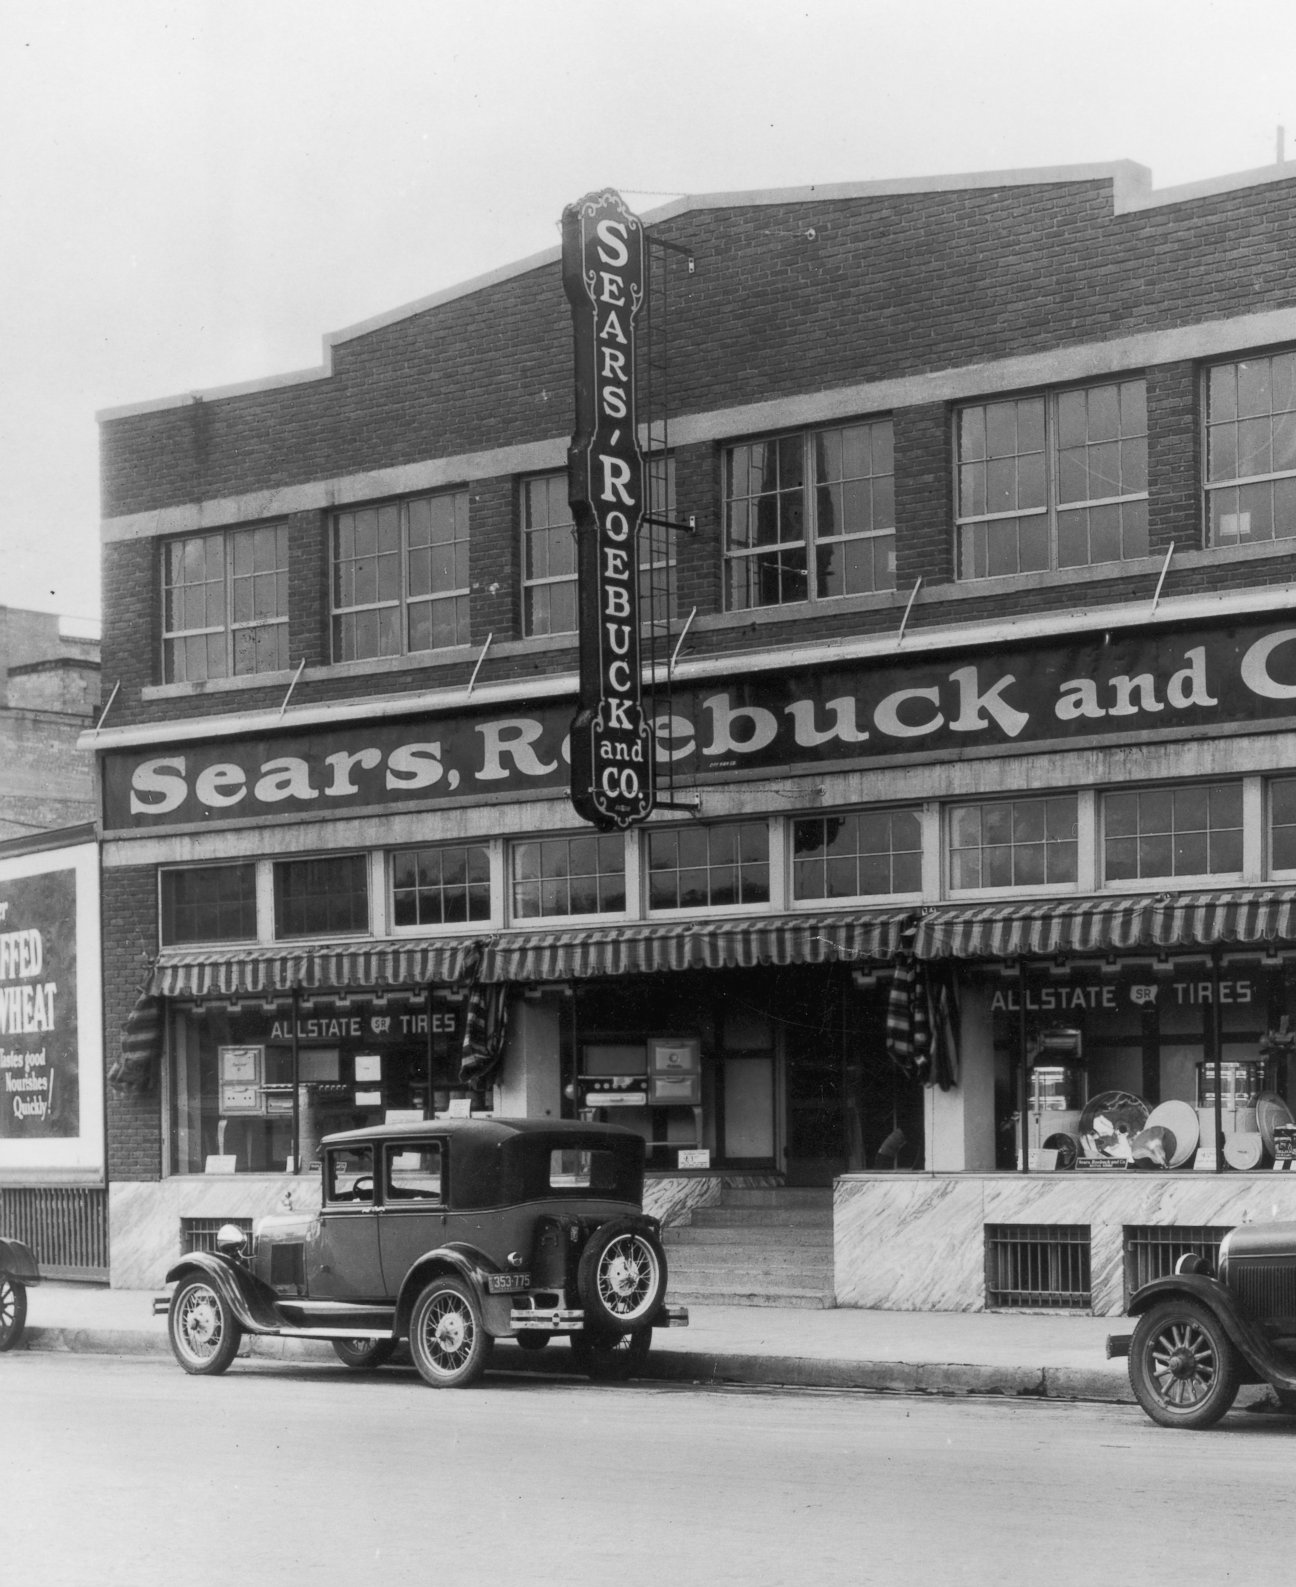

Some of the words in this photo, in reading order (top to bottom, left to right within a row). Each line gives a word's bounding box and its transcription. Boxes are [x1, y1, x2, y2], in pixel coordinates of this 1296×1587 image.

[599, 454, 634, 731] ROEBUCK
[130, 742, 460, 815] Sears,
[475, 666, 1030, 780] Rebuck
[1054, 646, 1218, 721] and
[600, 740, 644, 762] and
[602, 768, 644, 798] CO.
[990, 986, 1117, 1011] ALLSTATE
[1173, 981, 1251, 1005] TIRES
[271, 1018, 362, 1039] ALLSTATE
[400, 1014, 456, 1034] TIRES
[25, 1048, 46, 1073] good
[5, 1072, 48, 1092] Nourishes
